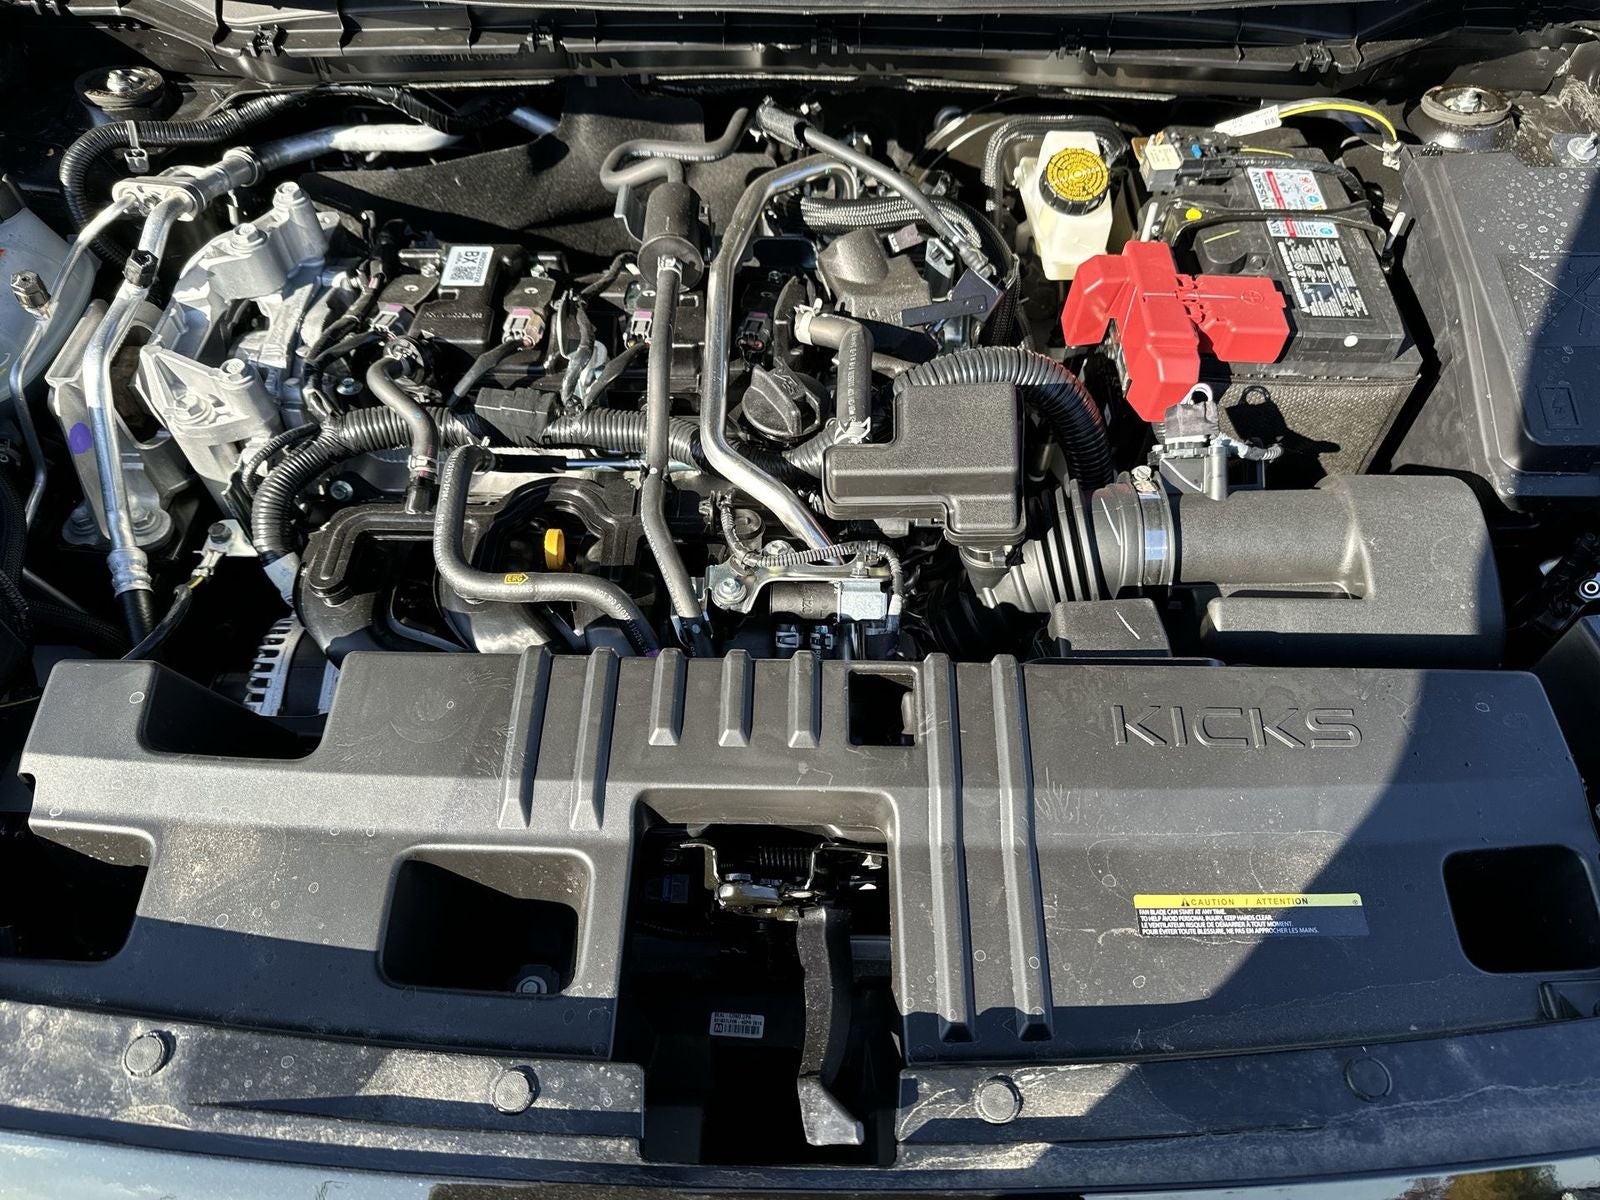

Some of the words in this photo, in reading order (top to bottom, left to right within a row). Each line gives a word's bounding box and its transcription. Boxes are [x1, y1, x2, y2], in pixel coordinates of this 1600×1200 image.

[1252, 171, 1269, 203] NISSAN
[462, 251, 480, 264] BX
[1111, 704, 1362, 749] KICKS
[1191, 898, 1235, 906] CAUTION
[1256, 897, 1309, 905] ATTENTION
